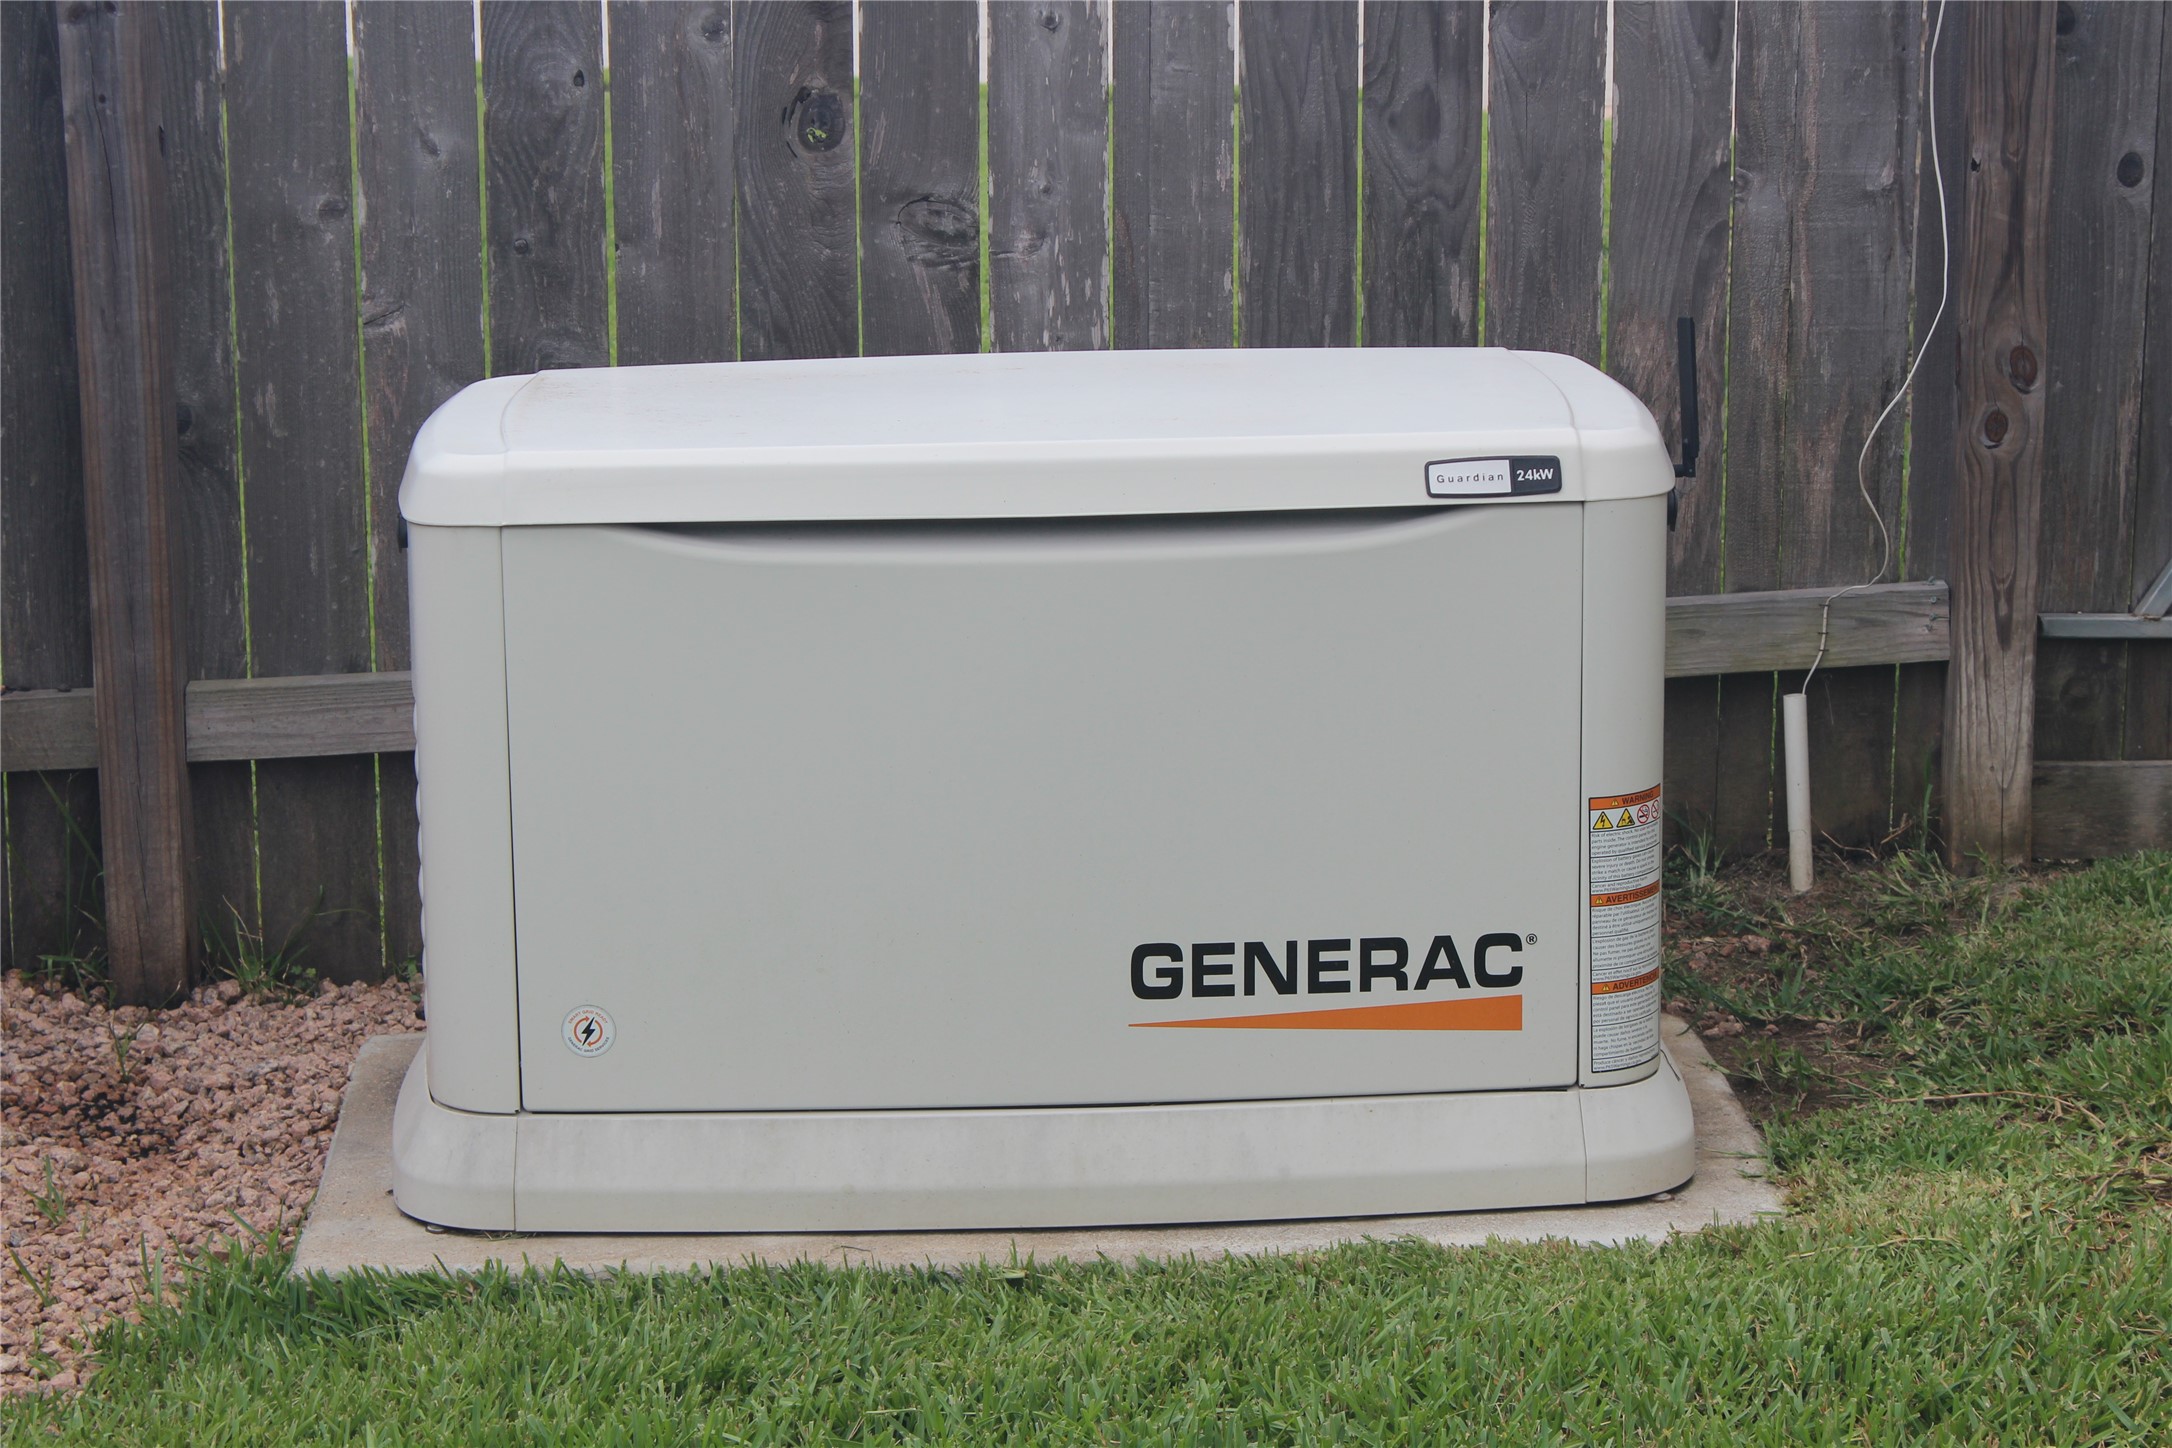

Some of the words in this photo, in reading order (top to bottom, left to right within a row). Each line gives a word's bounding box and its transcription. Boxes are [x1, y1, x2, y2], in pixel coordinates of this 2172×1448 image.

[1436, 473, 1504, 484] Guardian
[1516, 468, 1554, 482] 24kW
[1622, 791, 1654, 805] WARNING
